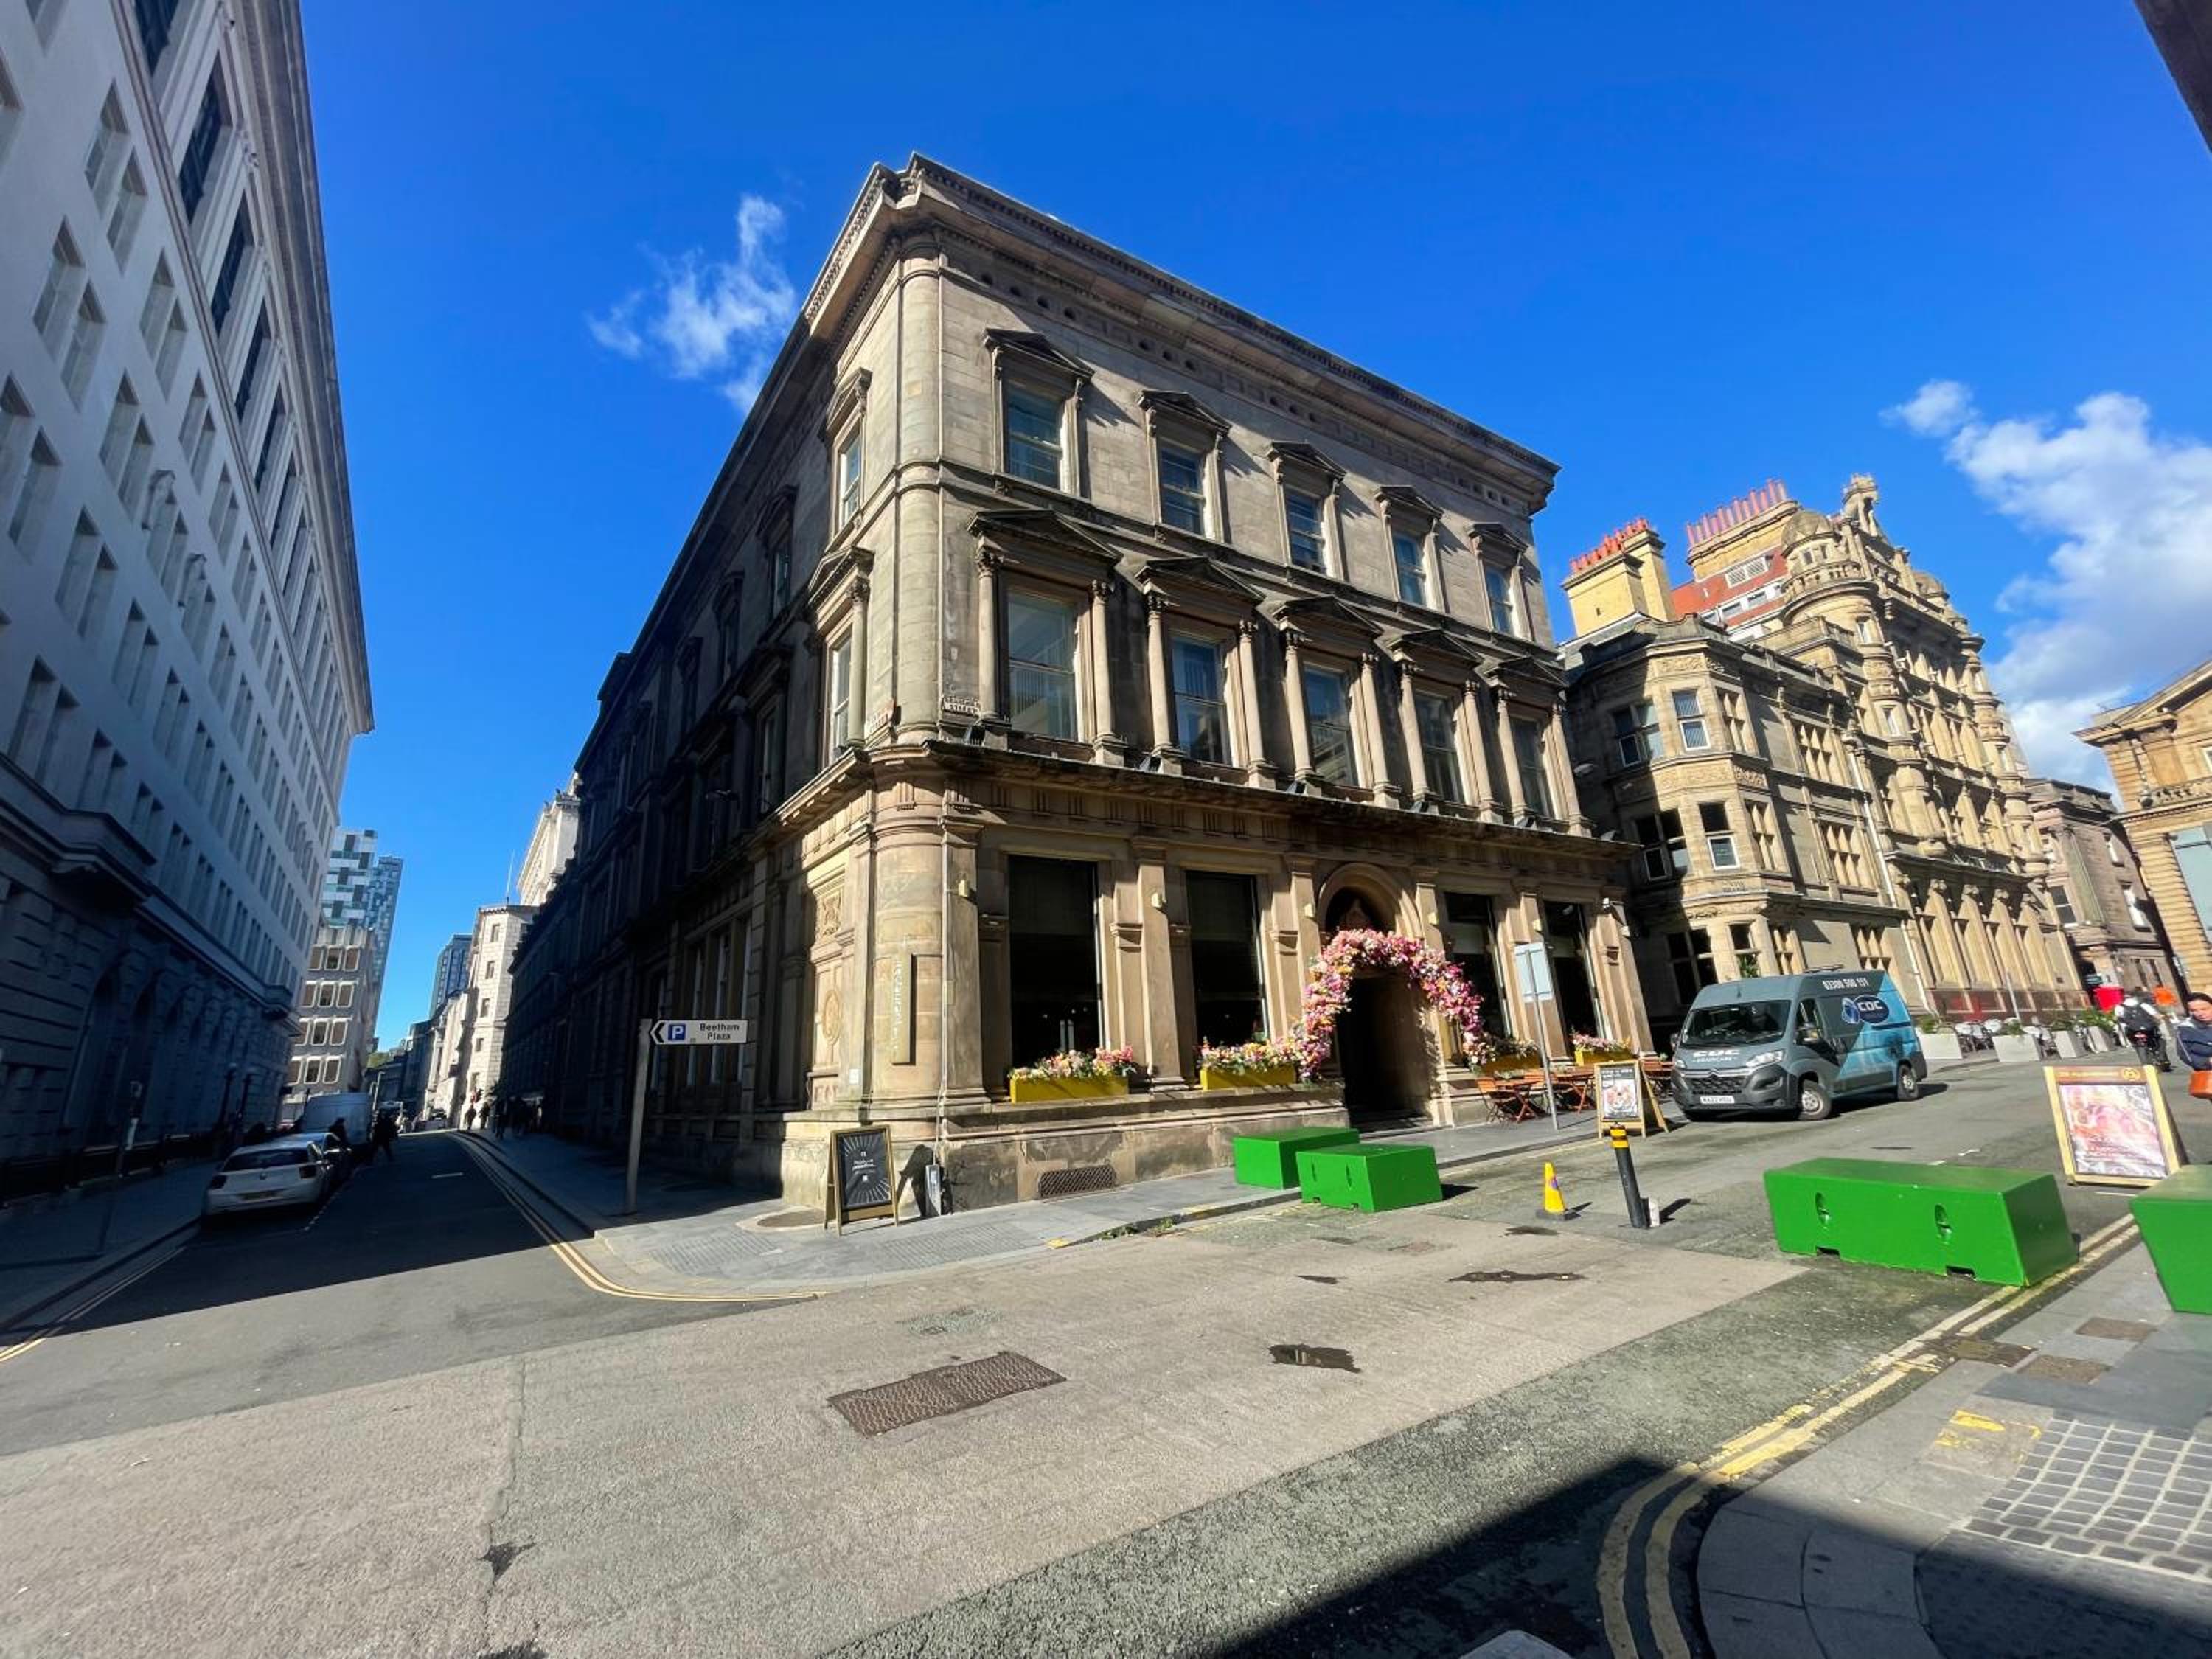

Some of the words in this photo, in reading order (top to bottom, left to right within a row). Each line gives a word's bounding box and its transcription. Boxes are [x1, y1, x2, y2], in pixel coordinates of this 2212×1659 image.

[700, 1023, 740, 1032] Beetham
[672, 1026, 684, 1039] P
[708, 1032, 731, 1040] Plaza
